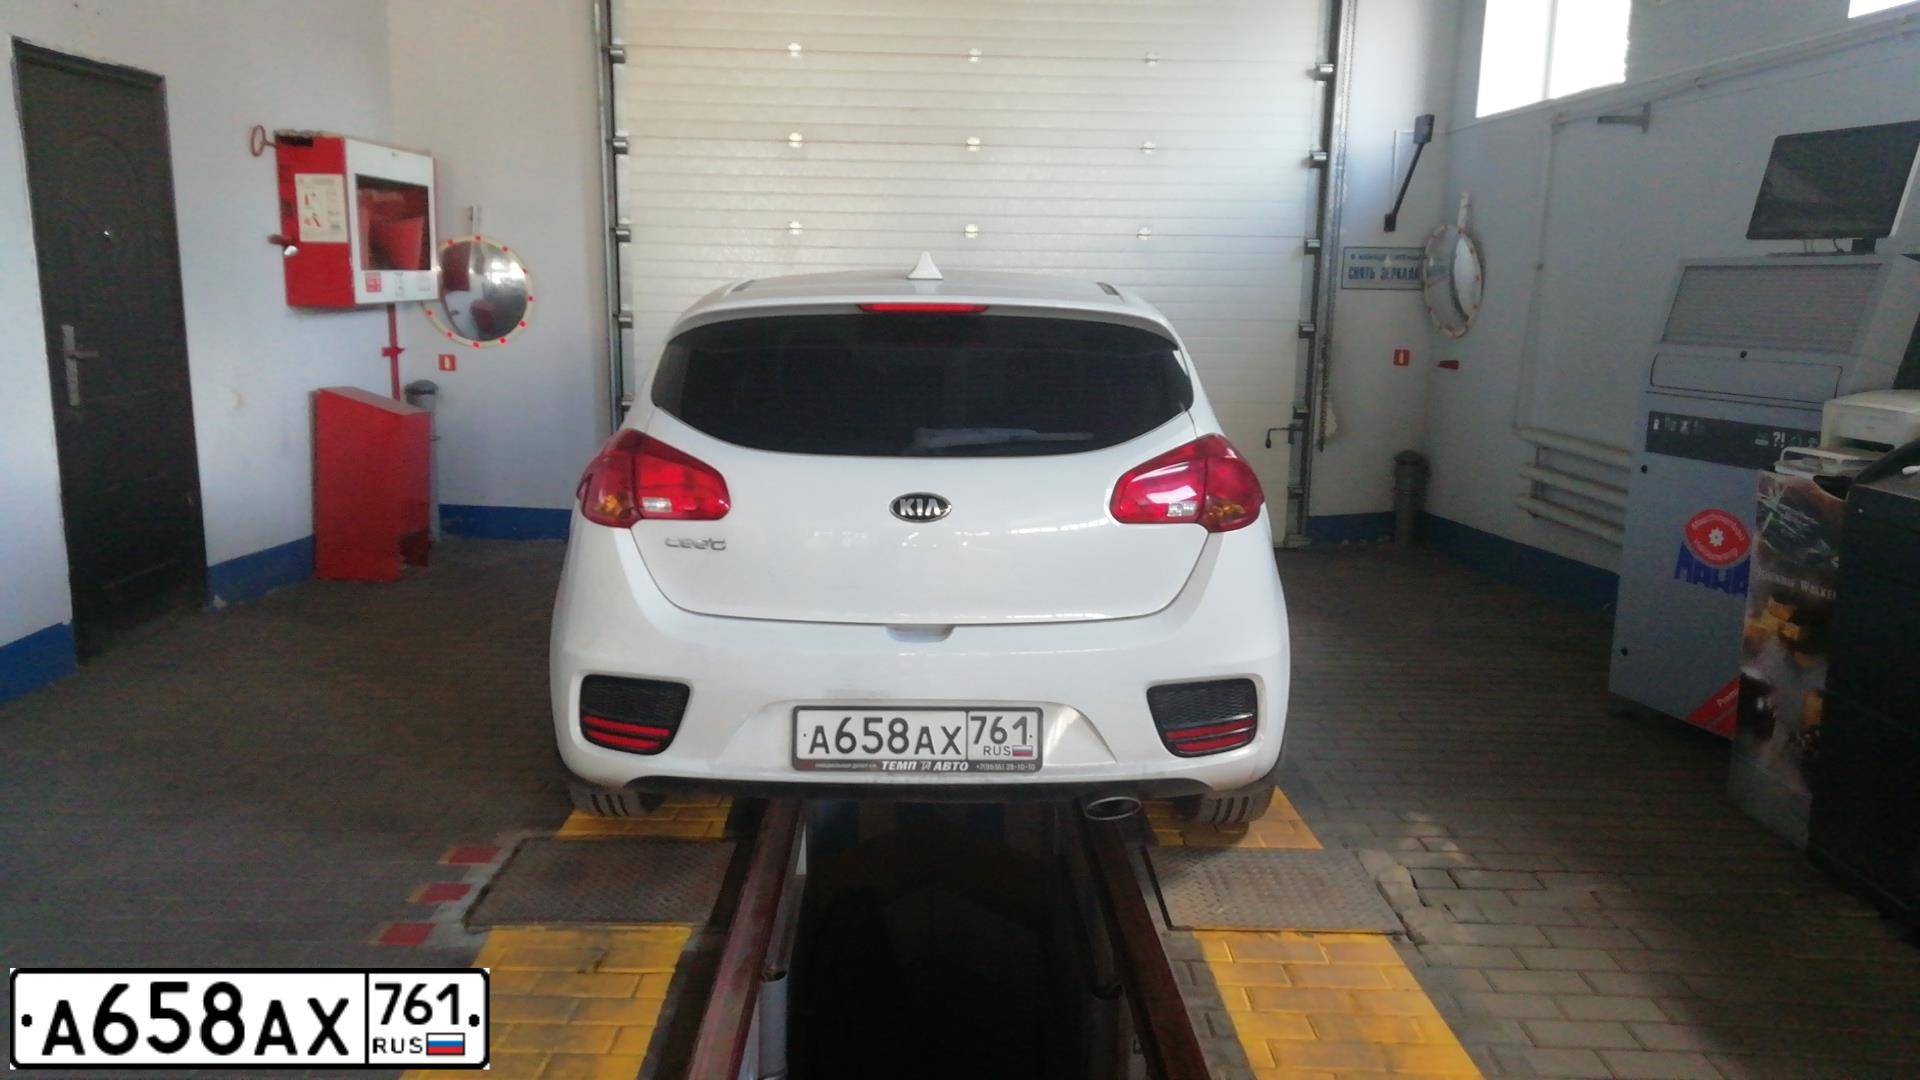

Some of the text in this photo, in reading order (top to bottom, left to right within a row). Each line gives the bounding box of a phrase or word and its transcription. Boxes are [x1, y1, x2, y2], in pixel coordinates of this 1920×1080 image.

[899, 498, 941, 517] KIA
[808, 715, 1028, 755] А658АХ 761
[983, 746, 1011, 757] RUS
[881, 760, 917, 771] ТЕМП
[933, 761, 969, 772] АВТО
